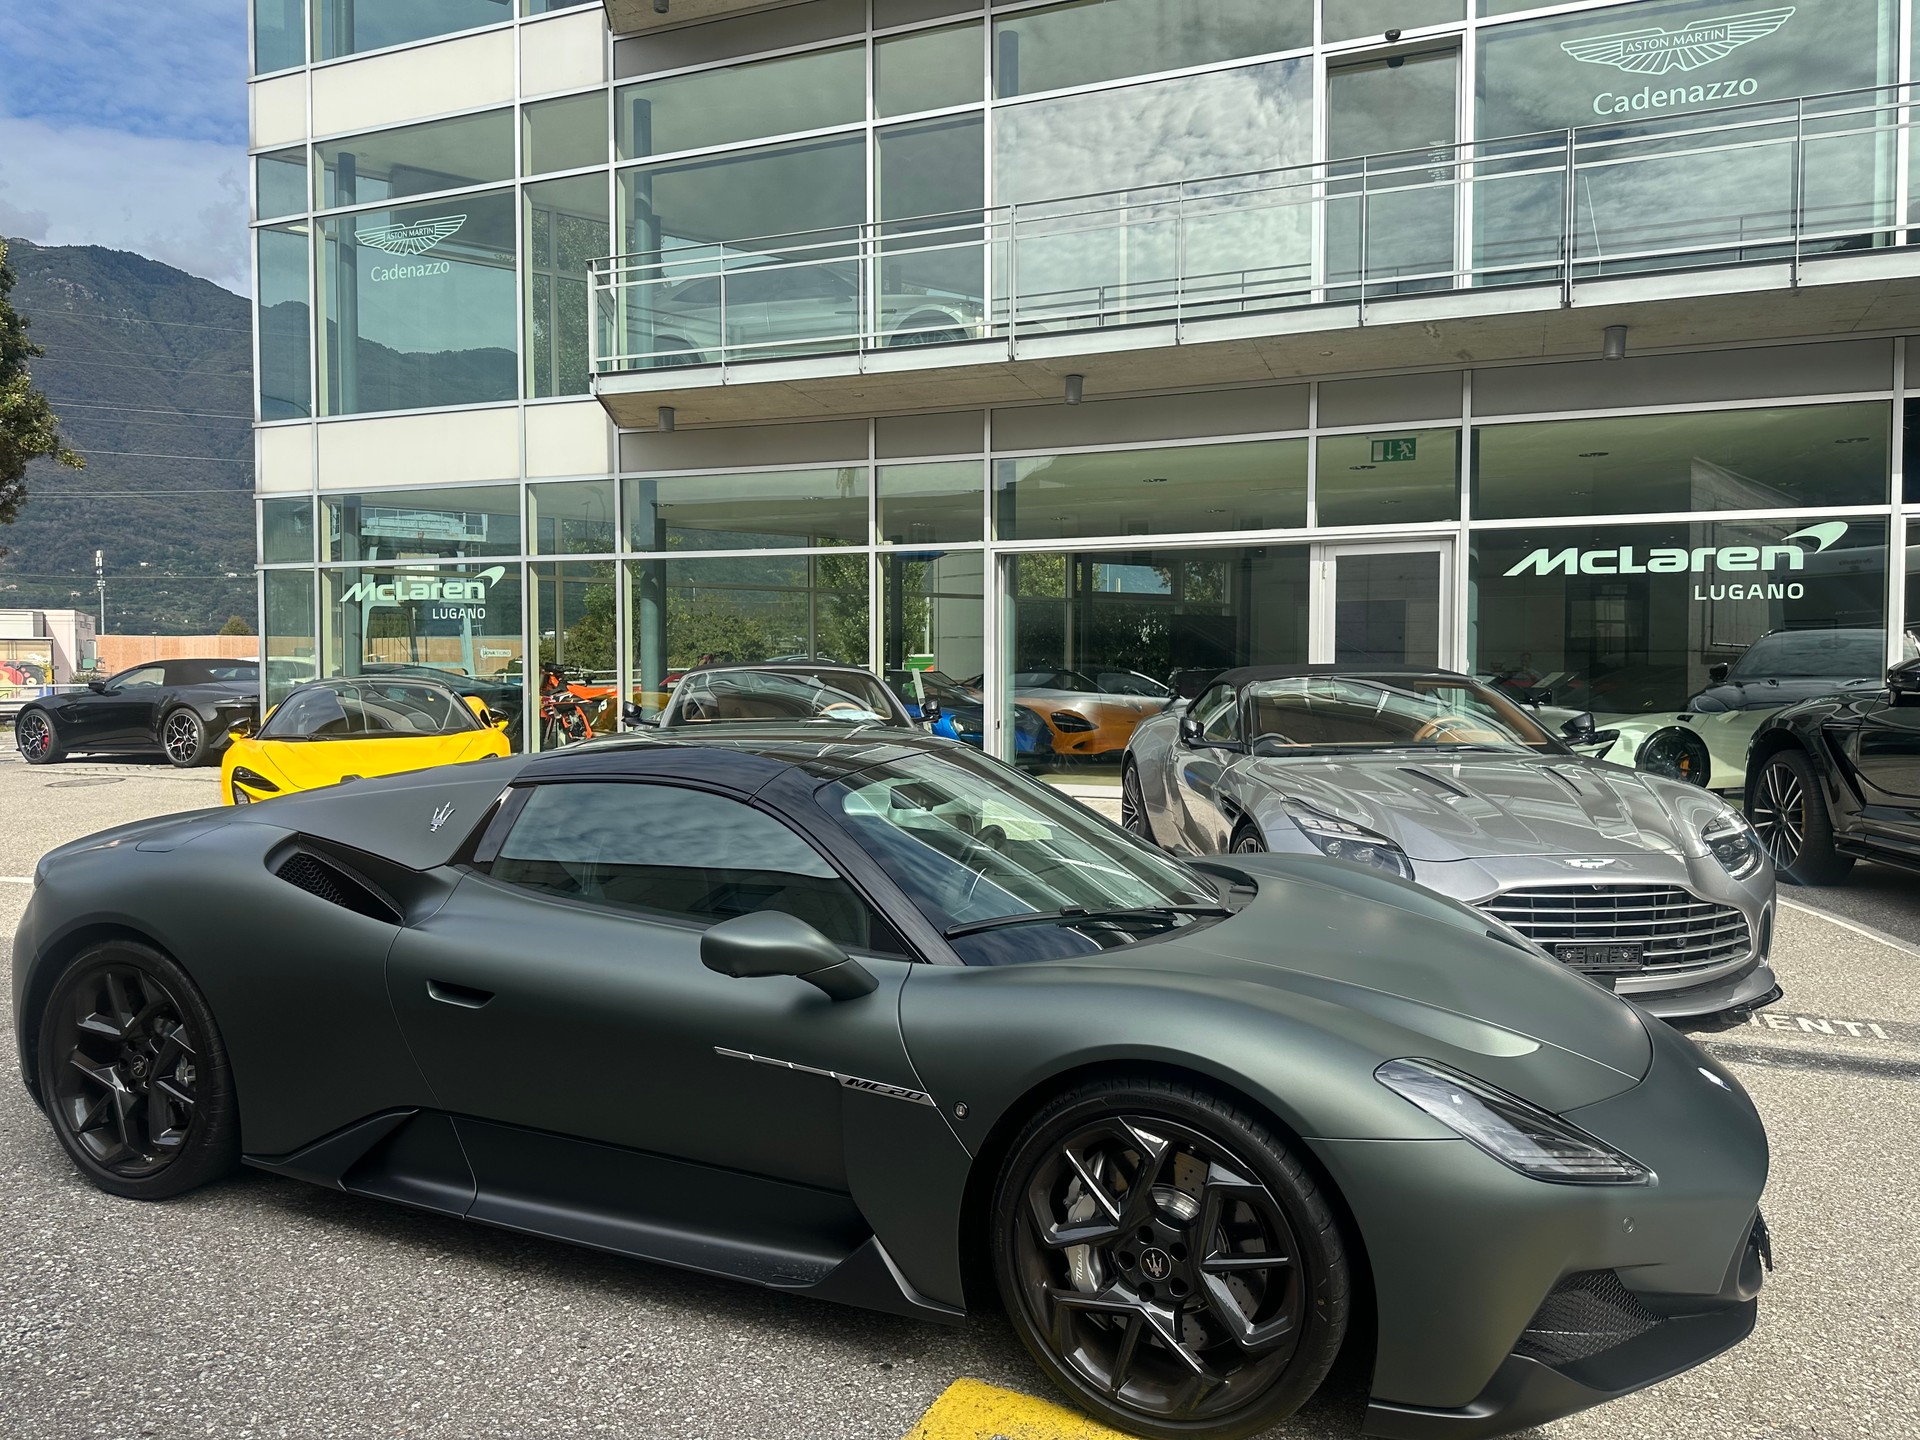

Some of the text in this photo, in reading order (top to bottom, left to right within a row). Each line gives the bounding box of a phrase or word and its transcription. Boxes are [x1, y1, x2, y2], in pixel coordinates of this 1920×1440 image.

[1625, 29, 1725, 53] ASTON MARTIN
[1592, 76, 1758, 116] Cadenazzo
[386, 227, 434, 240] ASTON MARTIN
[370, 261, 450, 282] Cadenazzo
[1502, 545, 1804, 577] McLaren
[339, 581, 486, 602] McLaren
[1694, 582, 1804, 601] LUGANO
[432, 607, 486, 620] LUGANO
[845, 1078, 925, 1101] MC20
